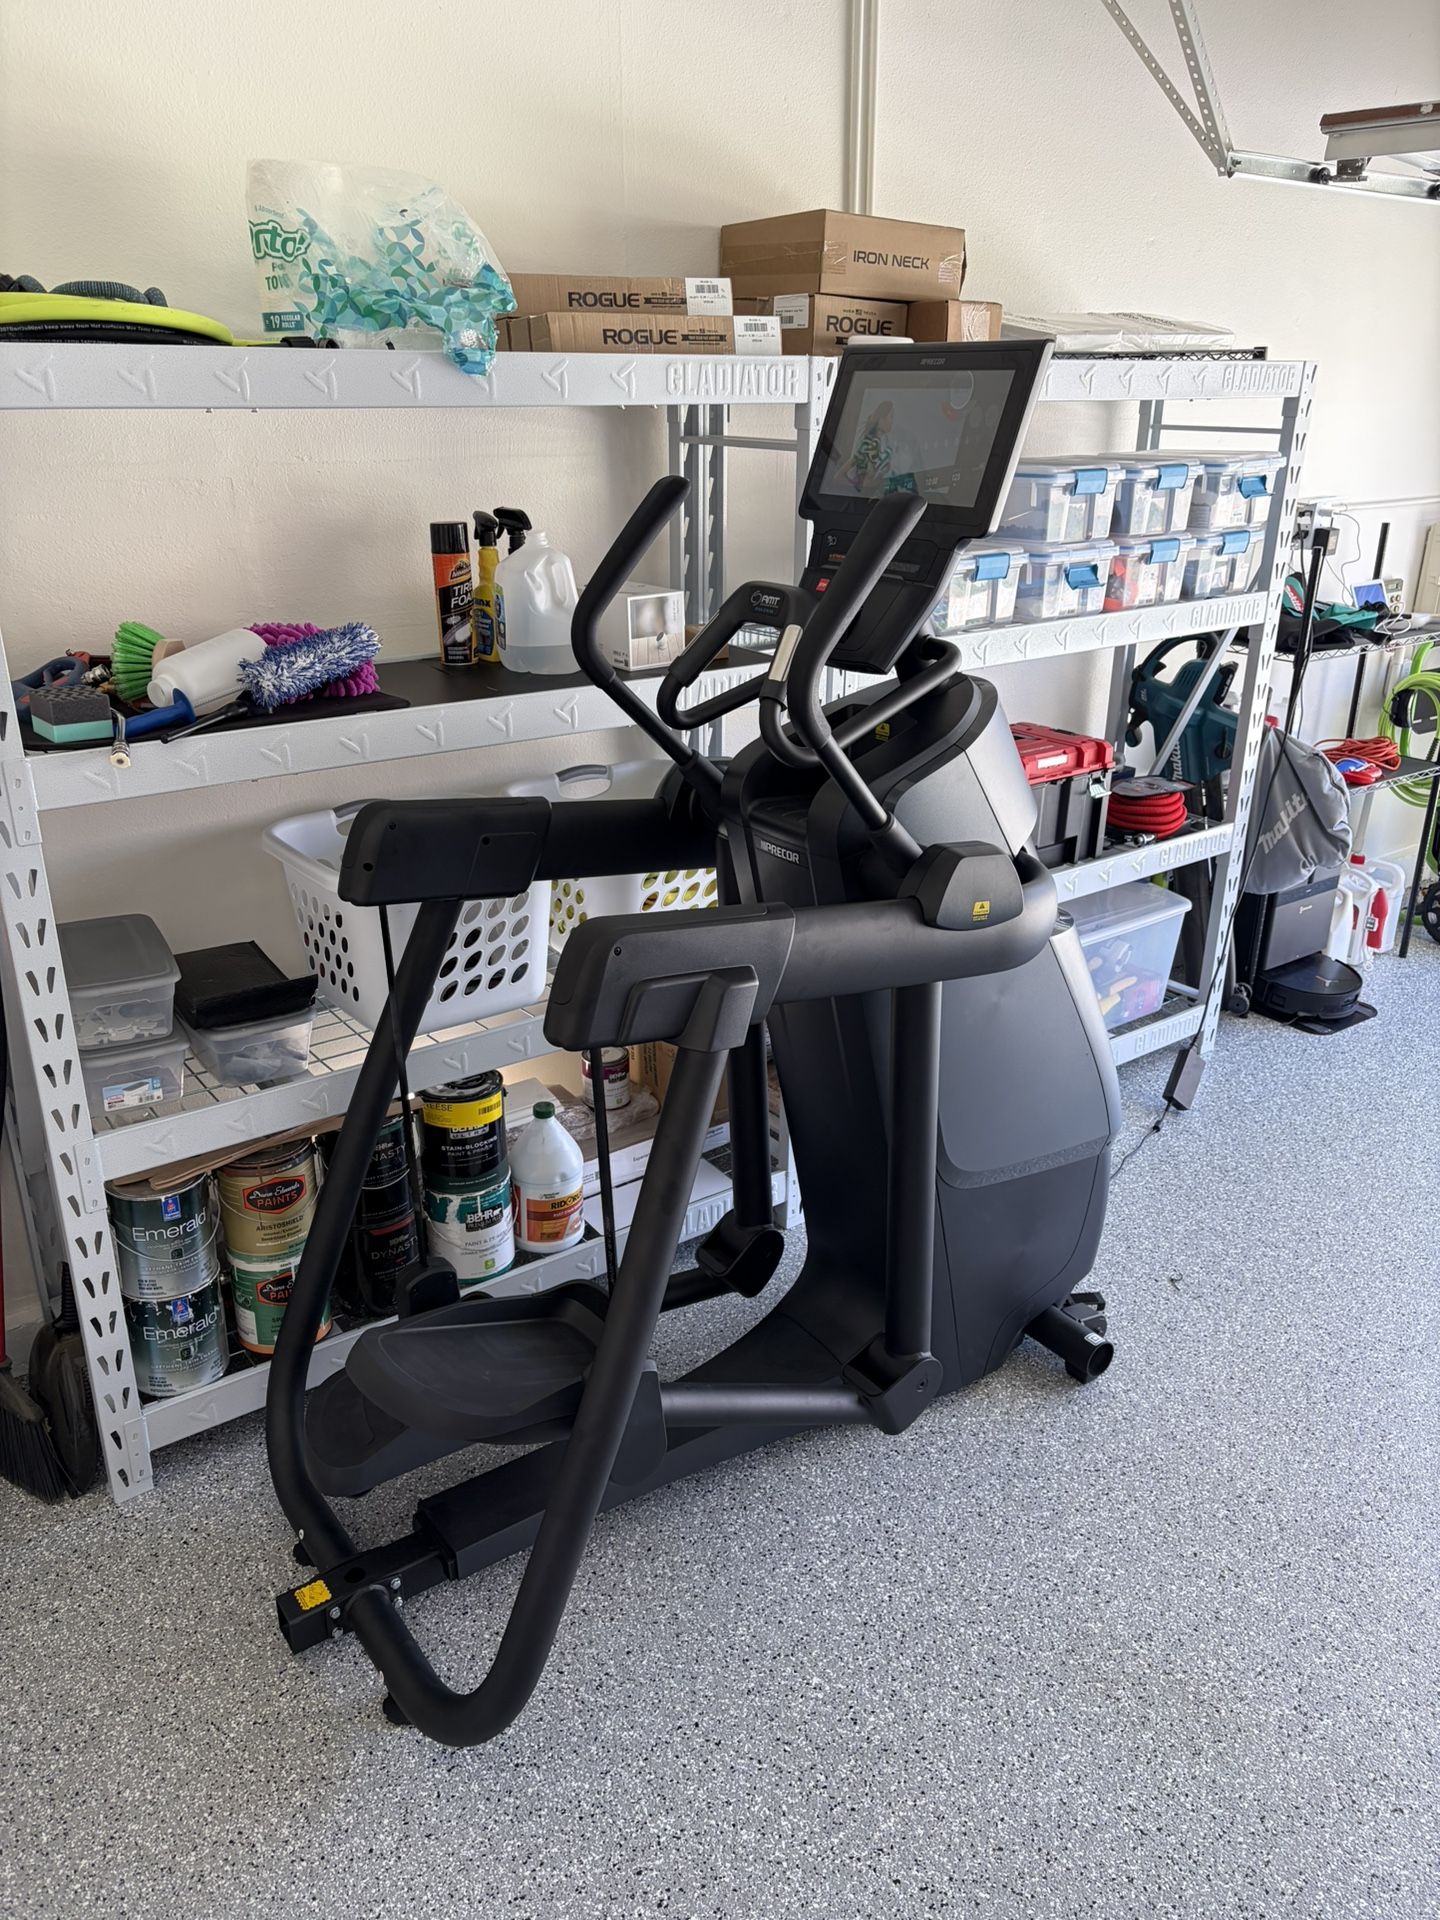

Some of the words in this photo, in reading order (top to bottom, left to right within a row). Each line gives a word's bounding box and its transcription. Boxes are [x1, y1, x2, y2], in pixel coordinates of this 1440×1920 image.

[853, 250, 888, 265] IRON
[892, 254, 930, 270] NECK
[568, 292, 641, 308] ROGUE
[271, 315, 280, 328] 19
[826, 315, 893, 336] ROGUE
[602, 328, 678, 345] ROGUE
[666, 360, 801, 397] GLADIATOR
[1222, 365, 1295, 392] GLADIATOR
[451, 593, 473, 608] FOA
[1190, 600, 1262, 629] GLADIATOR
[765, 842, 799, 864] PRECOR
[1160, 831, 1228, 866] GLADIATOR
[1135, 1013, 1200, 1053] GLADIATOR
[441, 1135, 497, 1151] STAIN-BLOCKING
[256, 1190, 298, 1207] PAINTS
[132, 1207, 207, 1242] Emerald
[256, 1215, 304, 1231] ARISTOSHIELD
[466, 1208, 494, 1224] BEHR
[270, 1290, 289, 1300] PAI
[143, 1304, 218, 1341] Emerald
